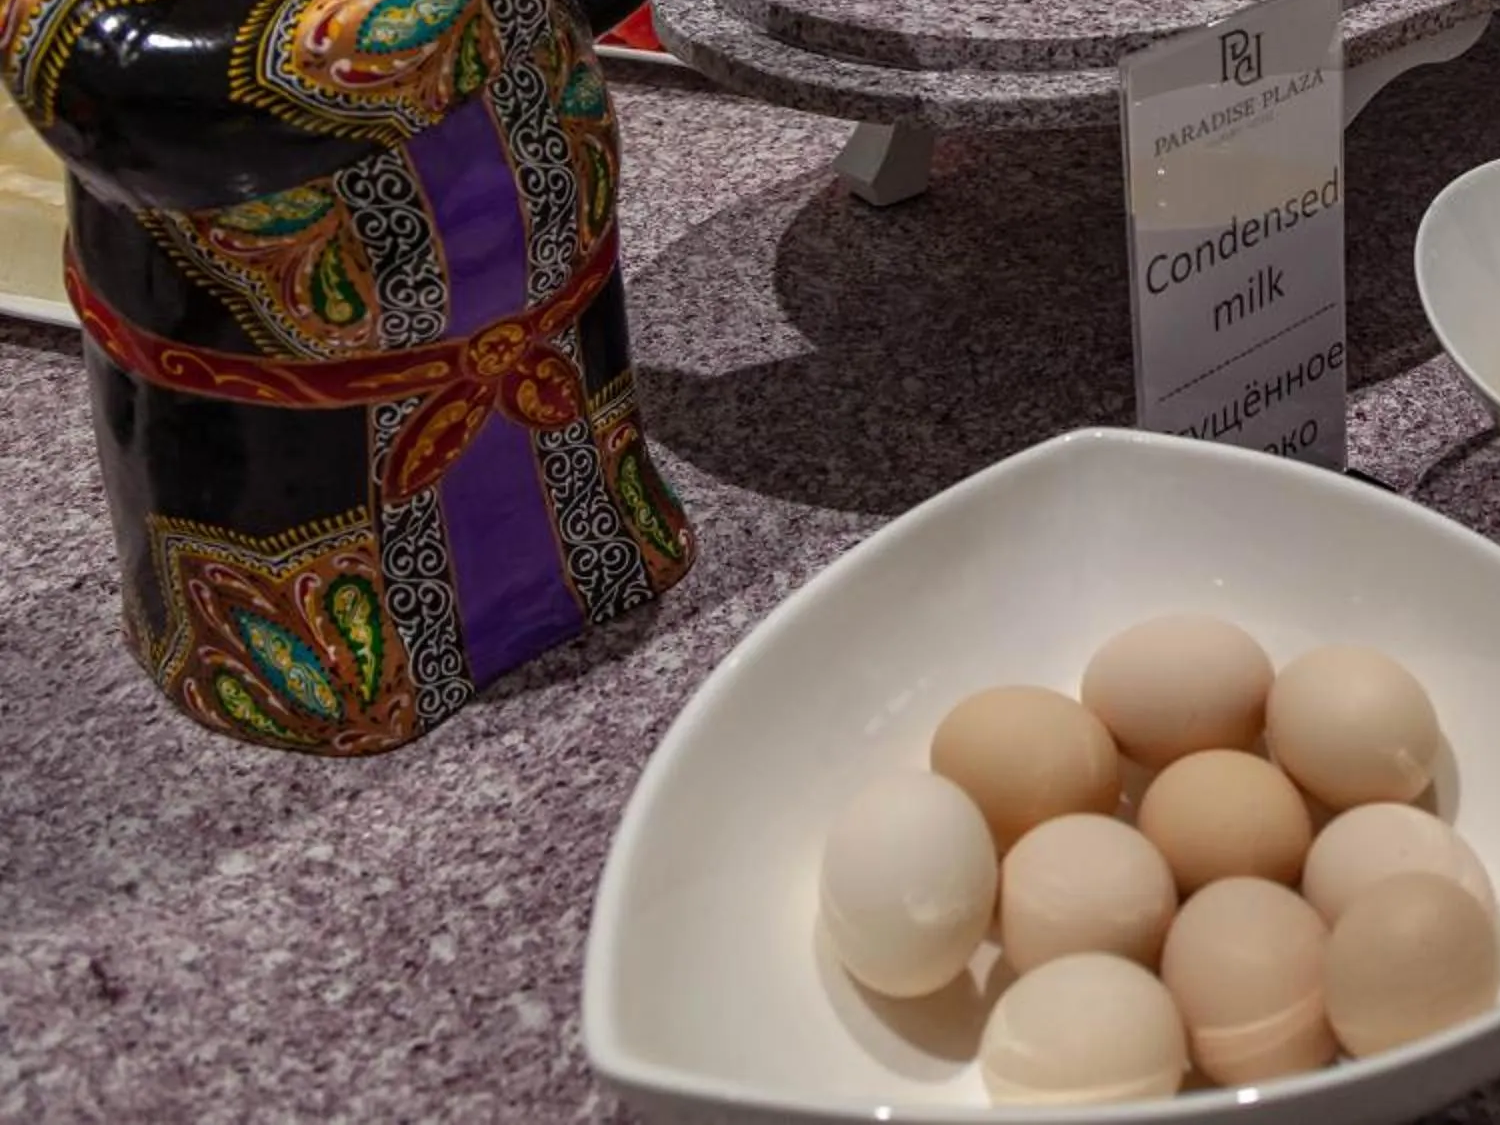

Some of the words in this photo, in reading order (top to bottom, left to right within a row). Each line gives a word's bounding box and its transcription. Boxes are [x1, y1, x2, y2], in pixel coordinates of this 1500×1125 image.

[1153, 97, 1256, 158] PARADISE
[1261, 67, 1326, 110] PLAZA
[1146, 167, 1340, 295] Condensed
[1213, 266, 1286, 332] milk
[1164, 341, 1344, 440] ущённое
